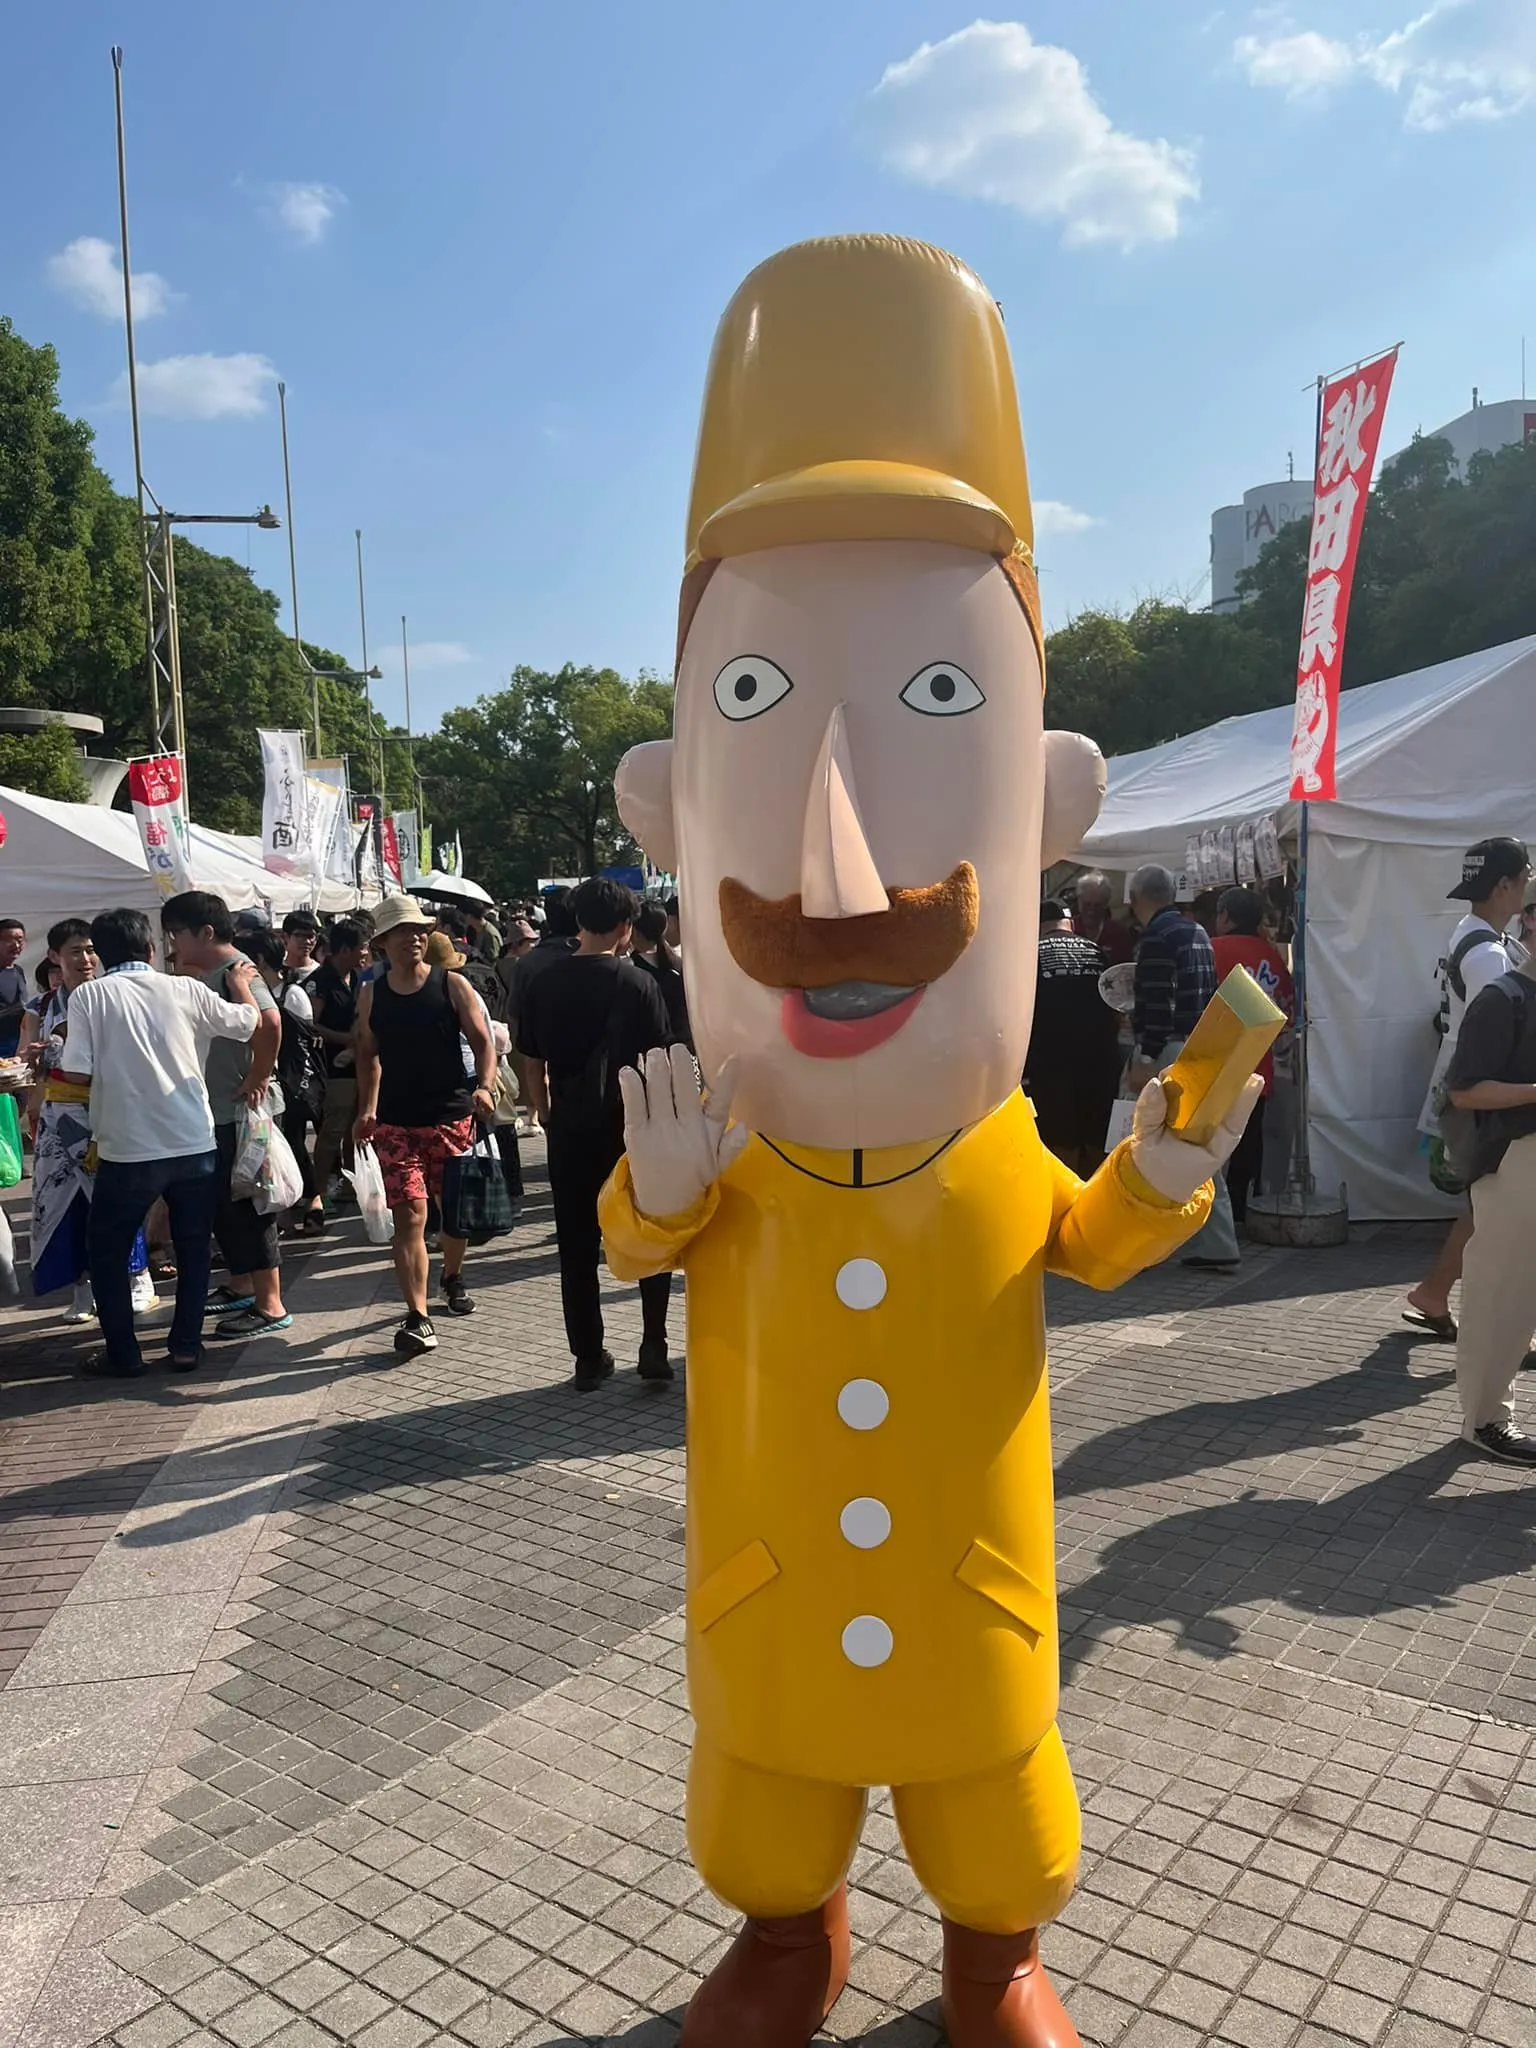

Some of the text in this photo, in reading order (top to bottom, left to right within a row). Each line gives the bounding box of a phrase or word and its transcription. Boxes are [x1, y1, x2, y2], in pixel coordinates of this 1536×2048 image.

[1245, 502, 1313, 542] PARC
[1299, 379, 1377, 674] 秋田県
